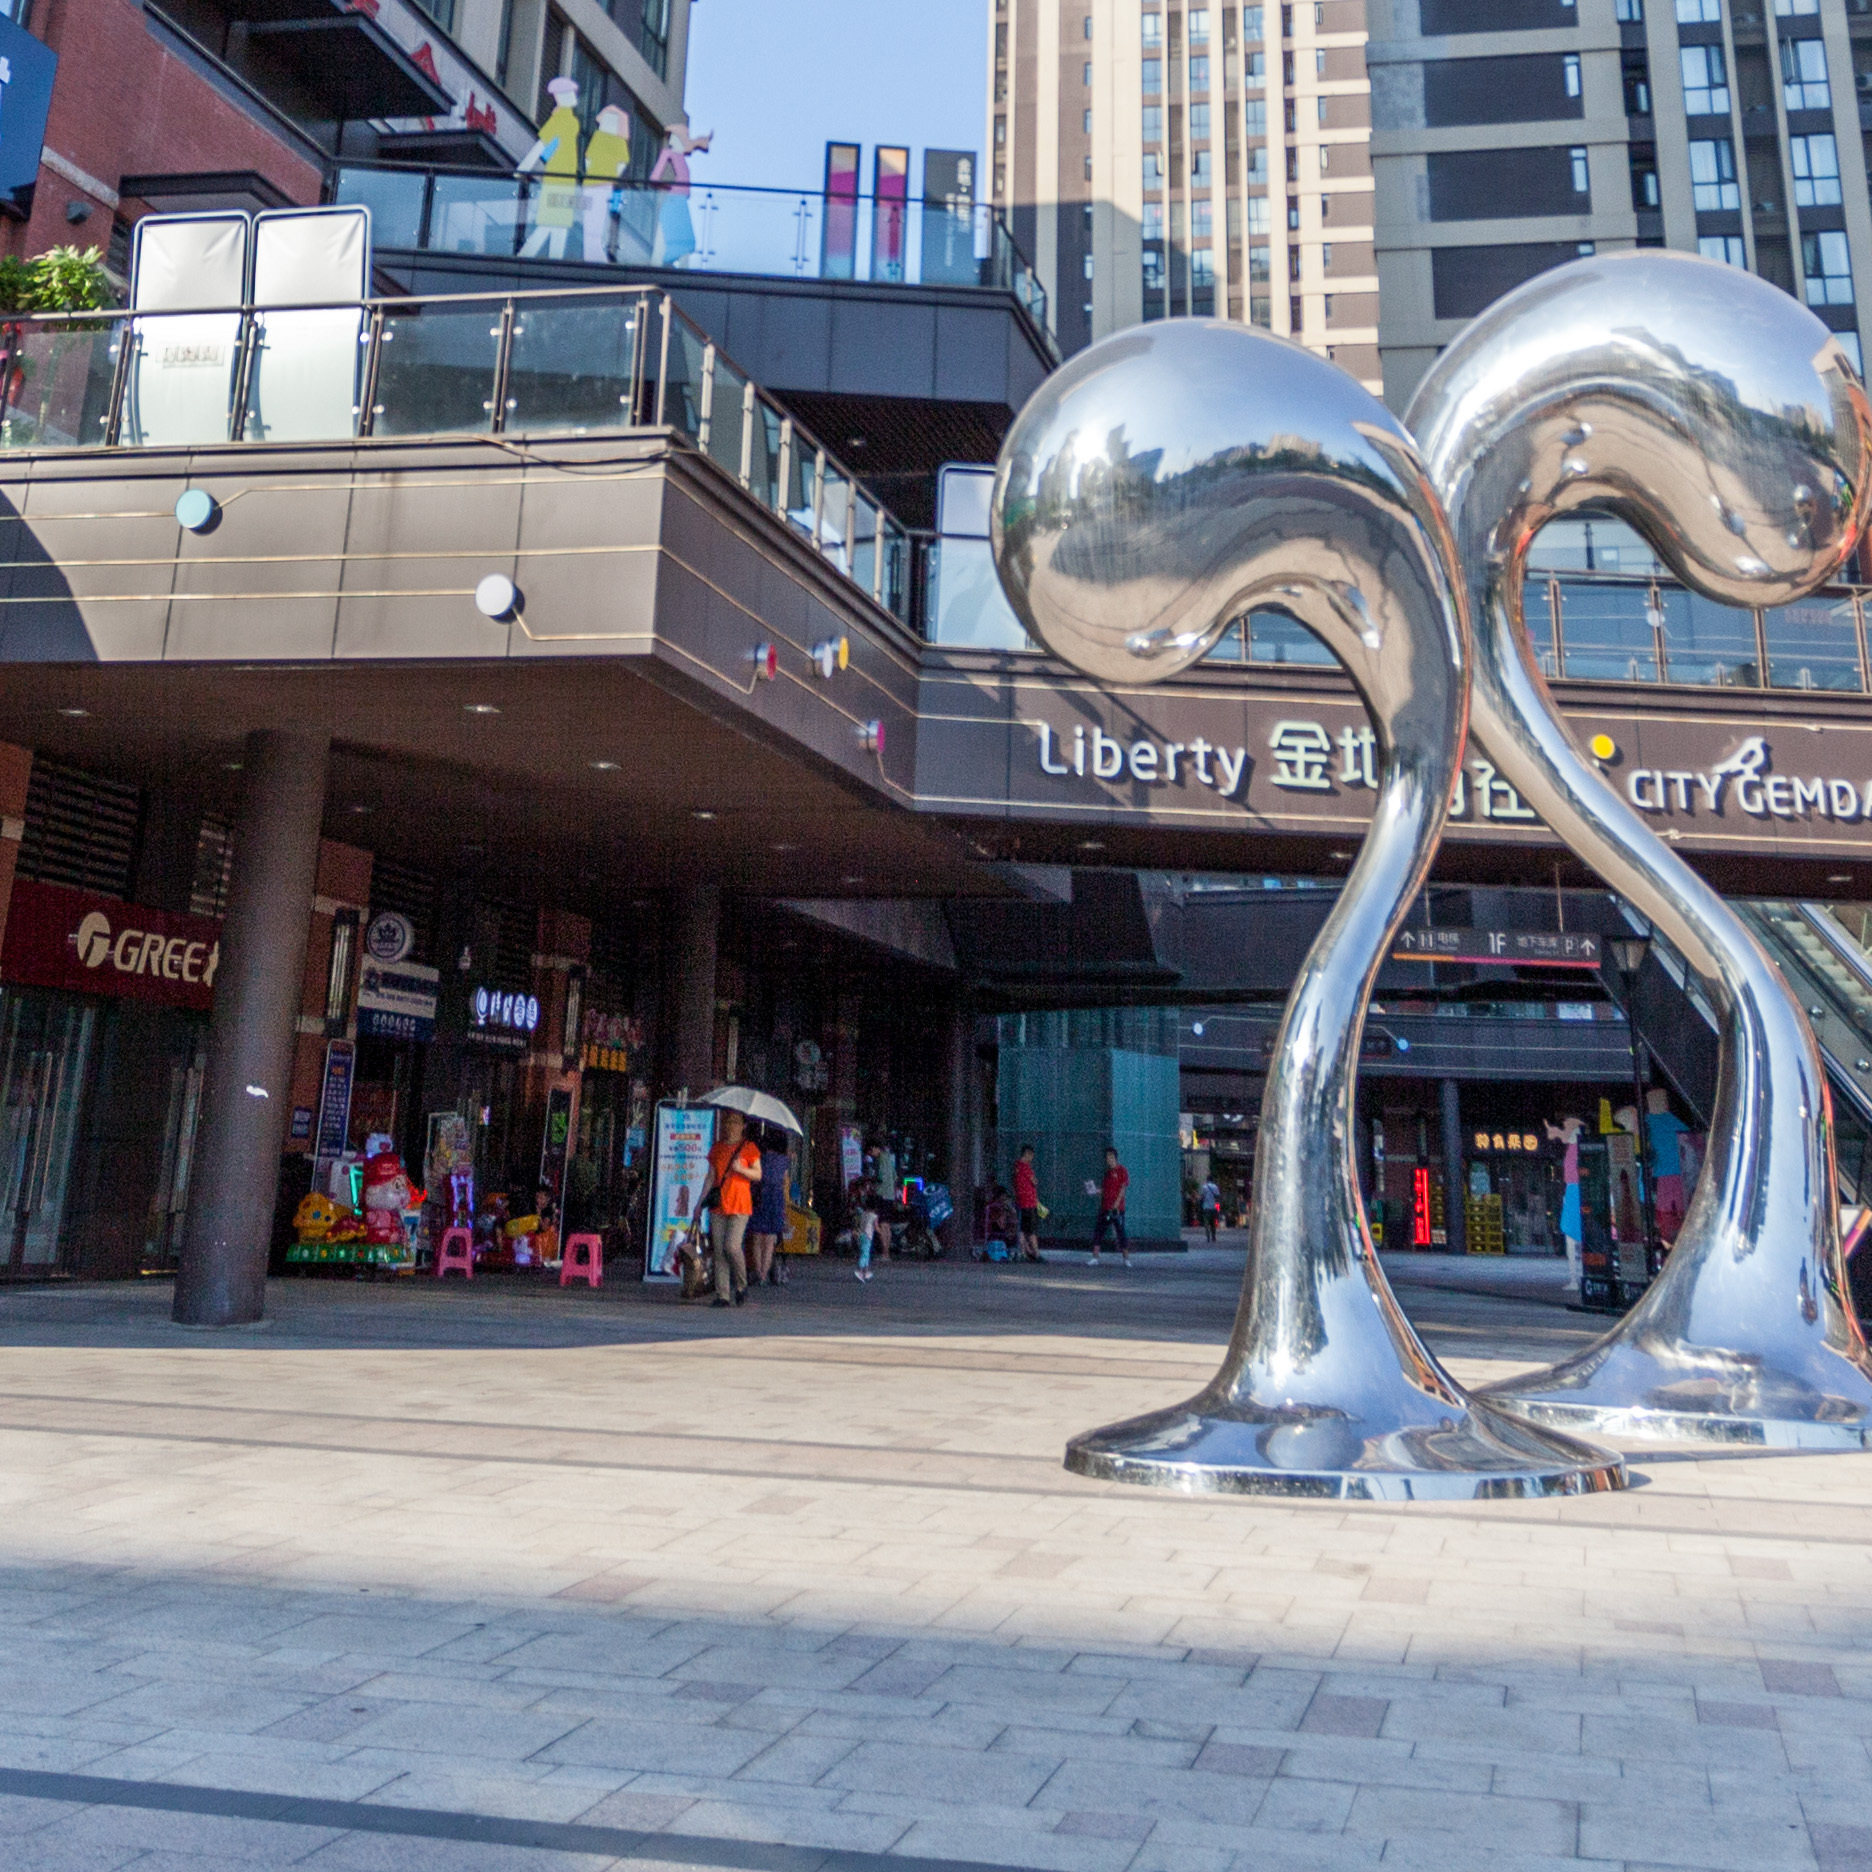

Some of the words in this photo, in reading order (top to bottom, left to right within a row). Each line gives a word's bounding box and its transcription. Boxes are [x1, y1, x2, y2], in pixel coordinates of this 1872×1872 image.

[1039, 723, 1246, 796] Liberty
[1628, 769, 1722, 812] CITY
[113, 928, 206, 983] GREE
[1488, 932, 1506, 954] 1F
